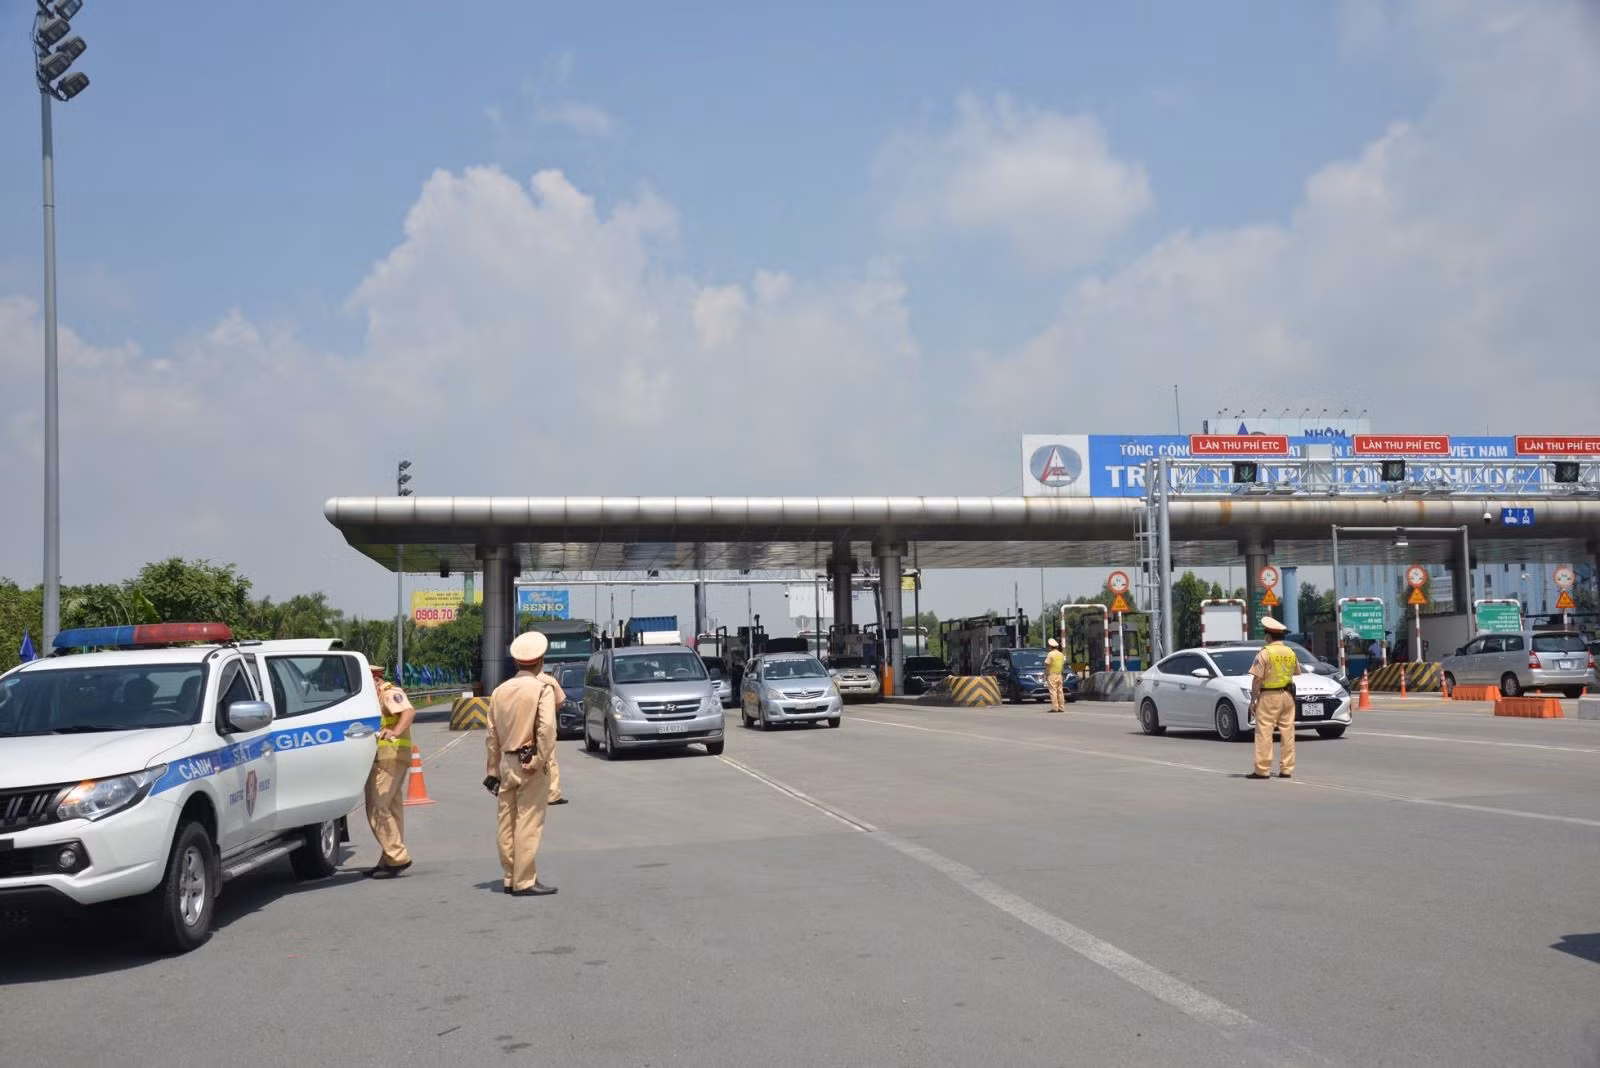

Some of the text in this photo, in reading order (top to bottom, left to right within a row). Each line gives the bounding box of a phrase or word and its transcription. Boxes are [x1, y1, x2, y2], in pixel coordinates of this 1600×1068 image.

[1304, 427, 1346, 438] NHÔM
[1199, 438, 1280, 450] LÀN THU PHÍ ETC
[1362, 438, 1441, 450] LÀN THU PHÍ ETC
[1524, 440, 1544, 451] LÀN
[1546, 442, 1565, 451] THU
[1567, 440, 1583, 451] PHÍ
[1479, 445, 1508, 458] NAM
[522, 603, 564, 612] SENKO
[275, 728, 333, 750] GIAO
